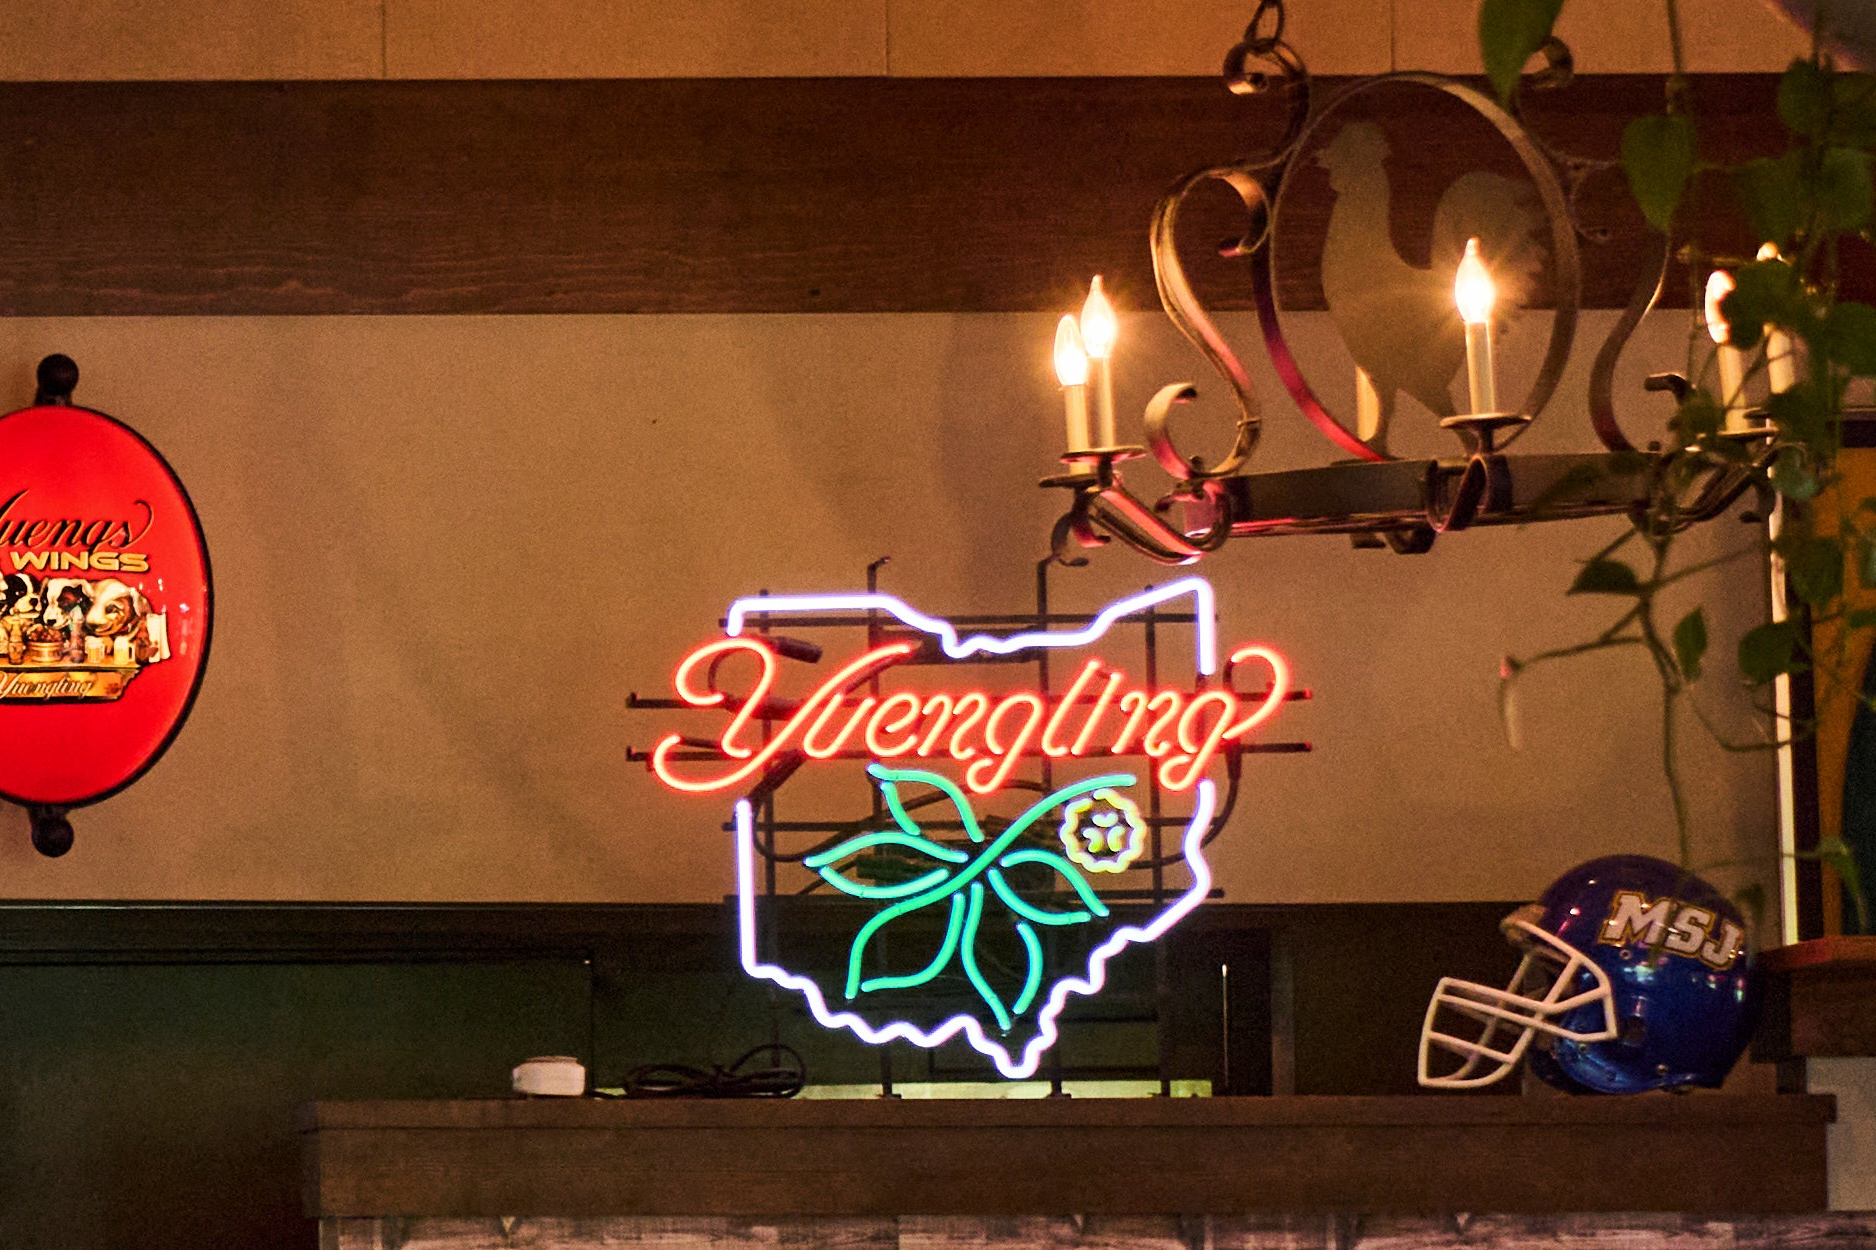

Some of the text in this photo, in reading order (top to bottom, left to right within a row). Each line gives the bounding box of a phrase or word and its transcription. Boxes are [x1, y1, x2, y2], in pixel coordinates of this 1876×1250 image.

[9, 551, 150, 573] WINGS
[651, 634, 1292, 795] Yuengling
[1597, 889, 1745, 972] MSJ
